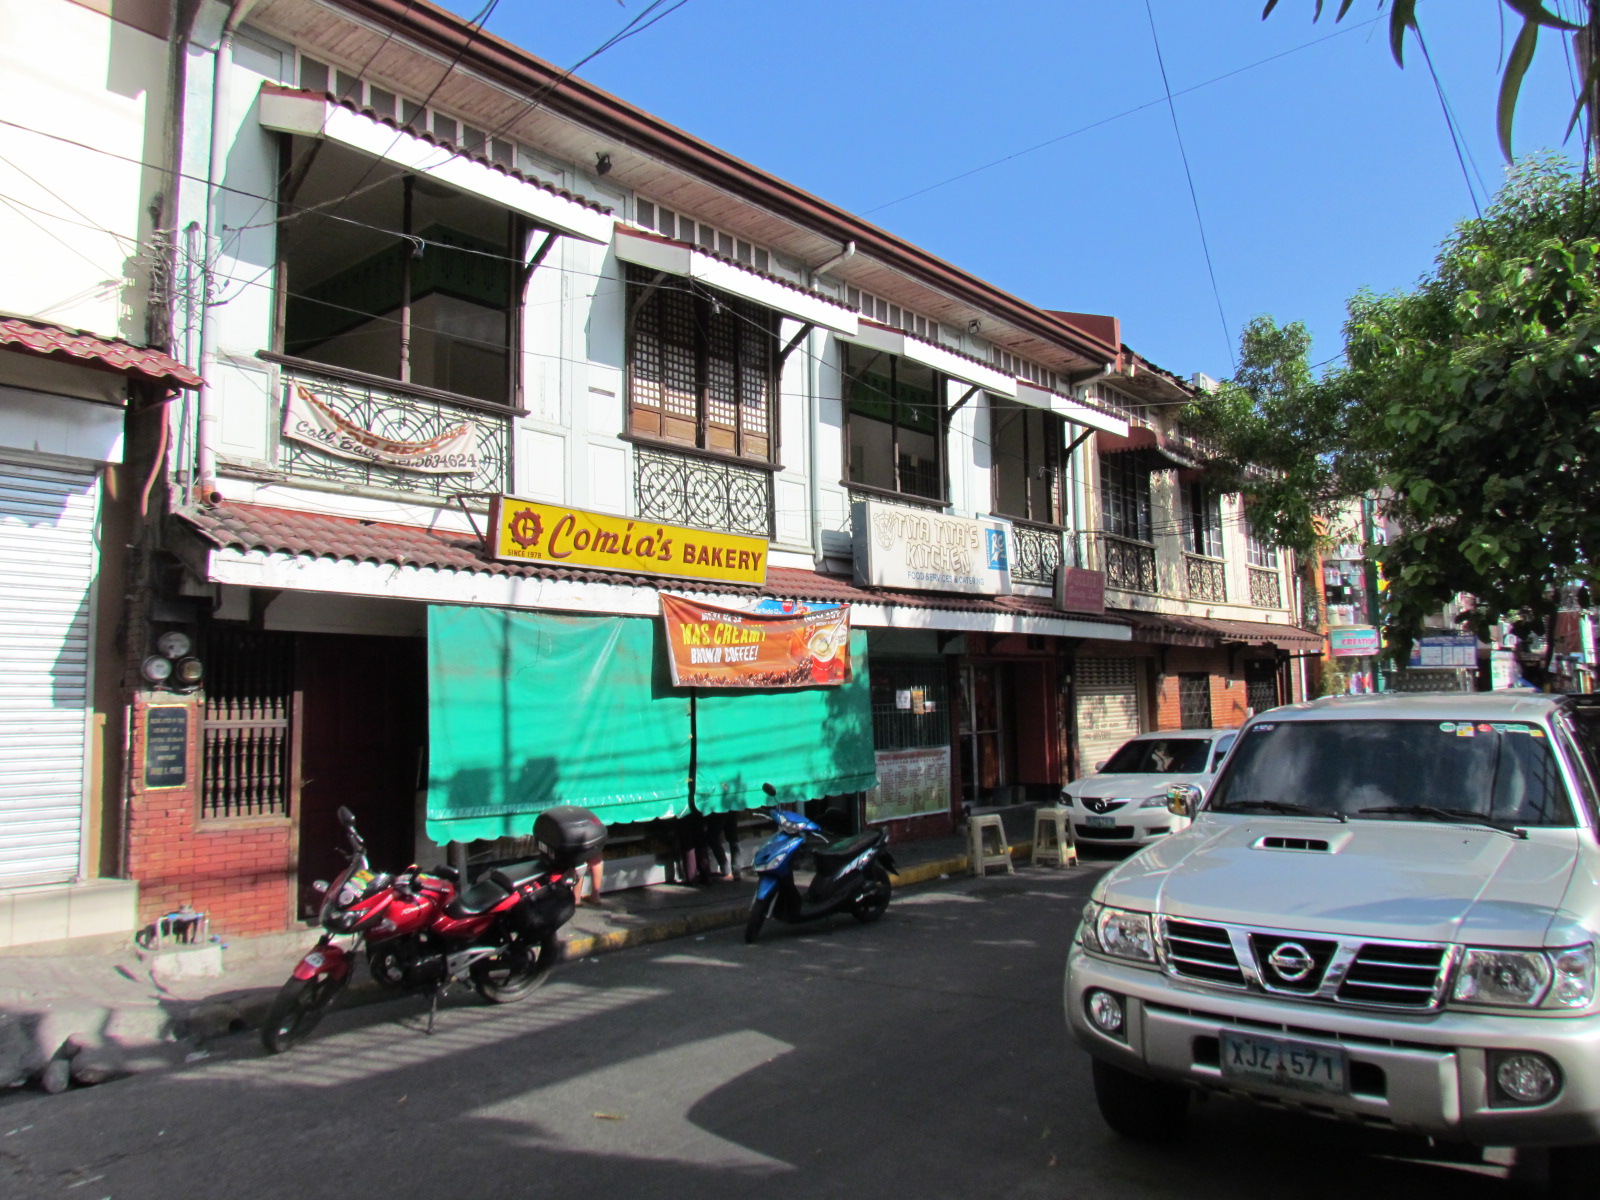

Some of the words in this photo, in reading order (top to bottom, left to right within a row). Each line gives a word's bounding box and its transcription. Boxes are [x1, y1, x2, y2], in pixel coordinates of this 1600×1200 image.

[295, 420, 335, 444] Call
[548, 513, 673, 562] Comia's
[682, 542, 763, 572] BAKERY
[895, 511, 931, 543] TITA
[933, 519, 980, 550] TITA'S
[507, 549, 526, 558] SINCE
[527, 551, 542, 559] 1978
[905, 541, 972, 574] KITCHEN
[907, 570, 925, 581] FOOD
[925, 573, 953, 584] SERVICES
[958, 576, 985, 586] CATERING
[680, 623, 710, 646] MAS
[690, 648, 722, 665] BROWN
[724, 645, 760, 663] COFFEE!
[1231, 1041, 1272, 1071] XJZ
[1291, 1051, 1334, 1081] 571
